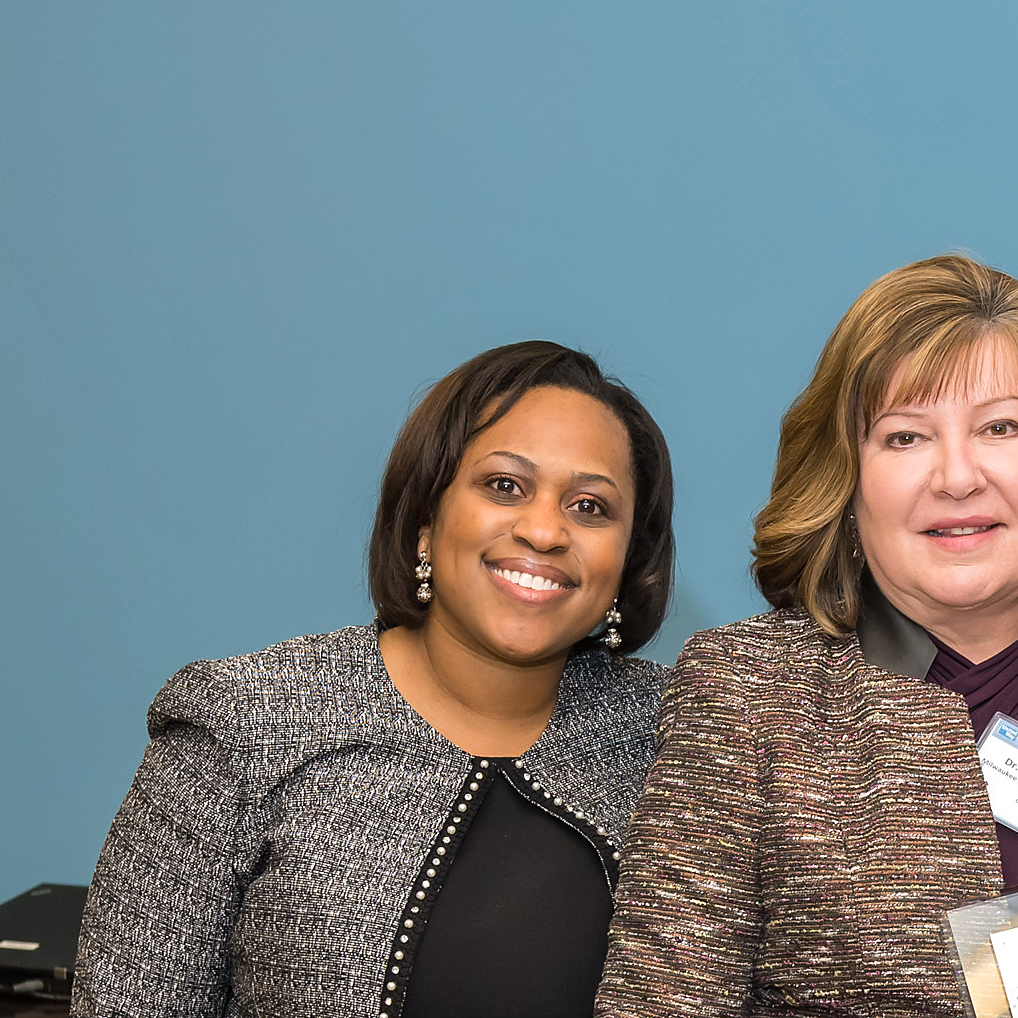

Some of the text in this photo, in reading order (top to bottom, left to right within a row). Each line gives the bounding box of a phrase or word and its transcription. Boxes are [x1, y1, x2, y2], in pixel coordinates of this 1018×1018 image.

[1002, 724, 1018, 735] United
[1005, 730, 1016, 741] Way
[982, 758, 1017, 782] Milwaukee
[1005, 758, 1018, 771] Dr.
